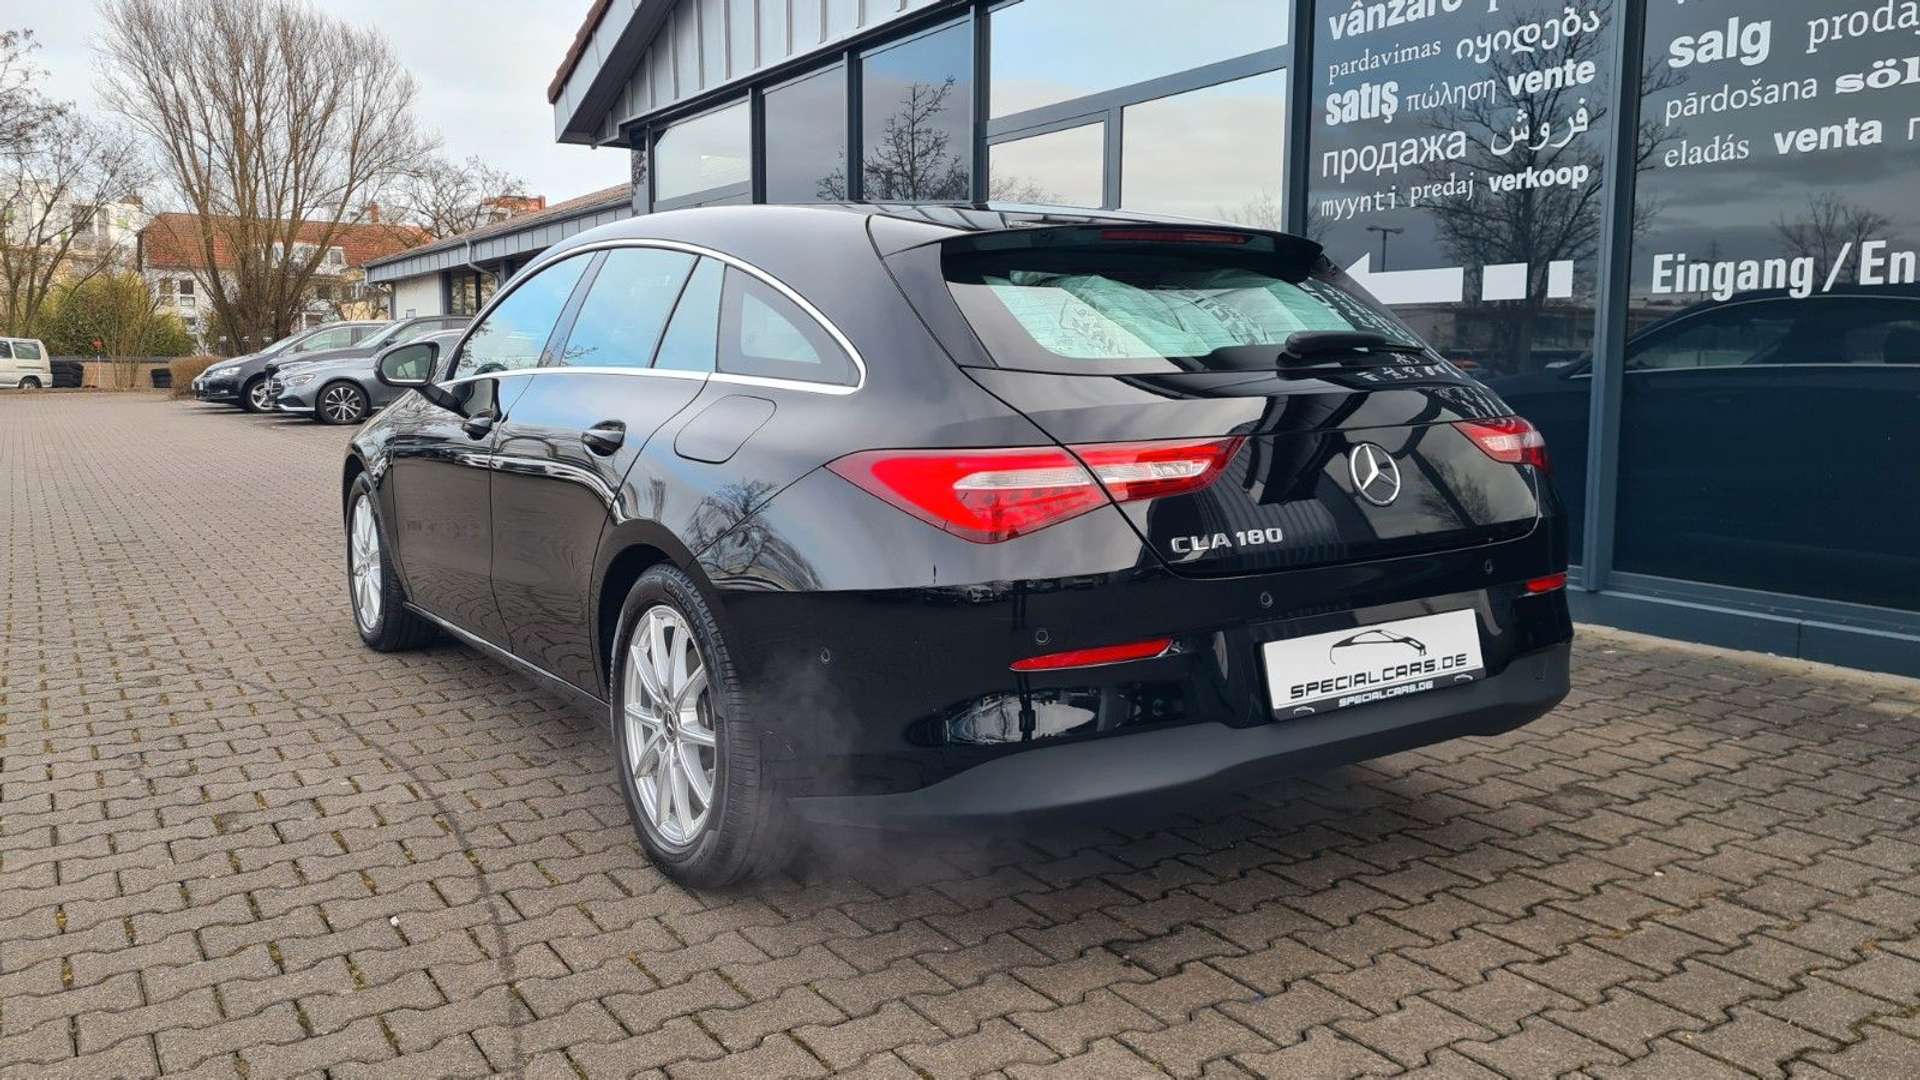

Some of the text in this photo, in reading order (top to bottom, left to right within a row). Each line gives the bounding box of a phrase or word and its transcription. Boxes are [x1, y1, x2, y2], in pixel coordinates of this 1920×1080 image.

[1456, 7, 1600, 63] იყიდება
[1668, 0, 1920, 68] salg proda
[1329, 40, 1441, 85] pardavimas
[1508, 60, 1595, 96] vente
[1325, 81, 1399, 124] satış
[1406, 78, 1496, 112] πώληση
[1665, 77, 1818, 127] pārdošana
[1491, 97, 1589, 155] فروش
[1664, 134, 1750, 167] eladás
[1774, 117, 1883, 154] venta
[1322, 129, 1467, 183] продажа
[1321, 164, 1589, 220] myynti predaj verkoop
[1651, 253, 1815, 302] Eingang
[1171, 527, 1284, 553] CLA 180
[1290, 653, 1467, 699] SPECIALCARS.DE
[1338, 680, 1433, 708] SPECIALCARS.DE
